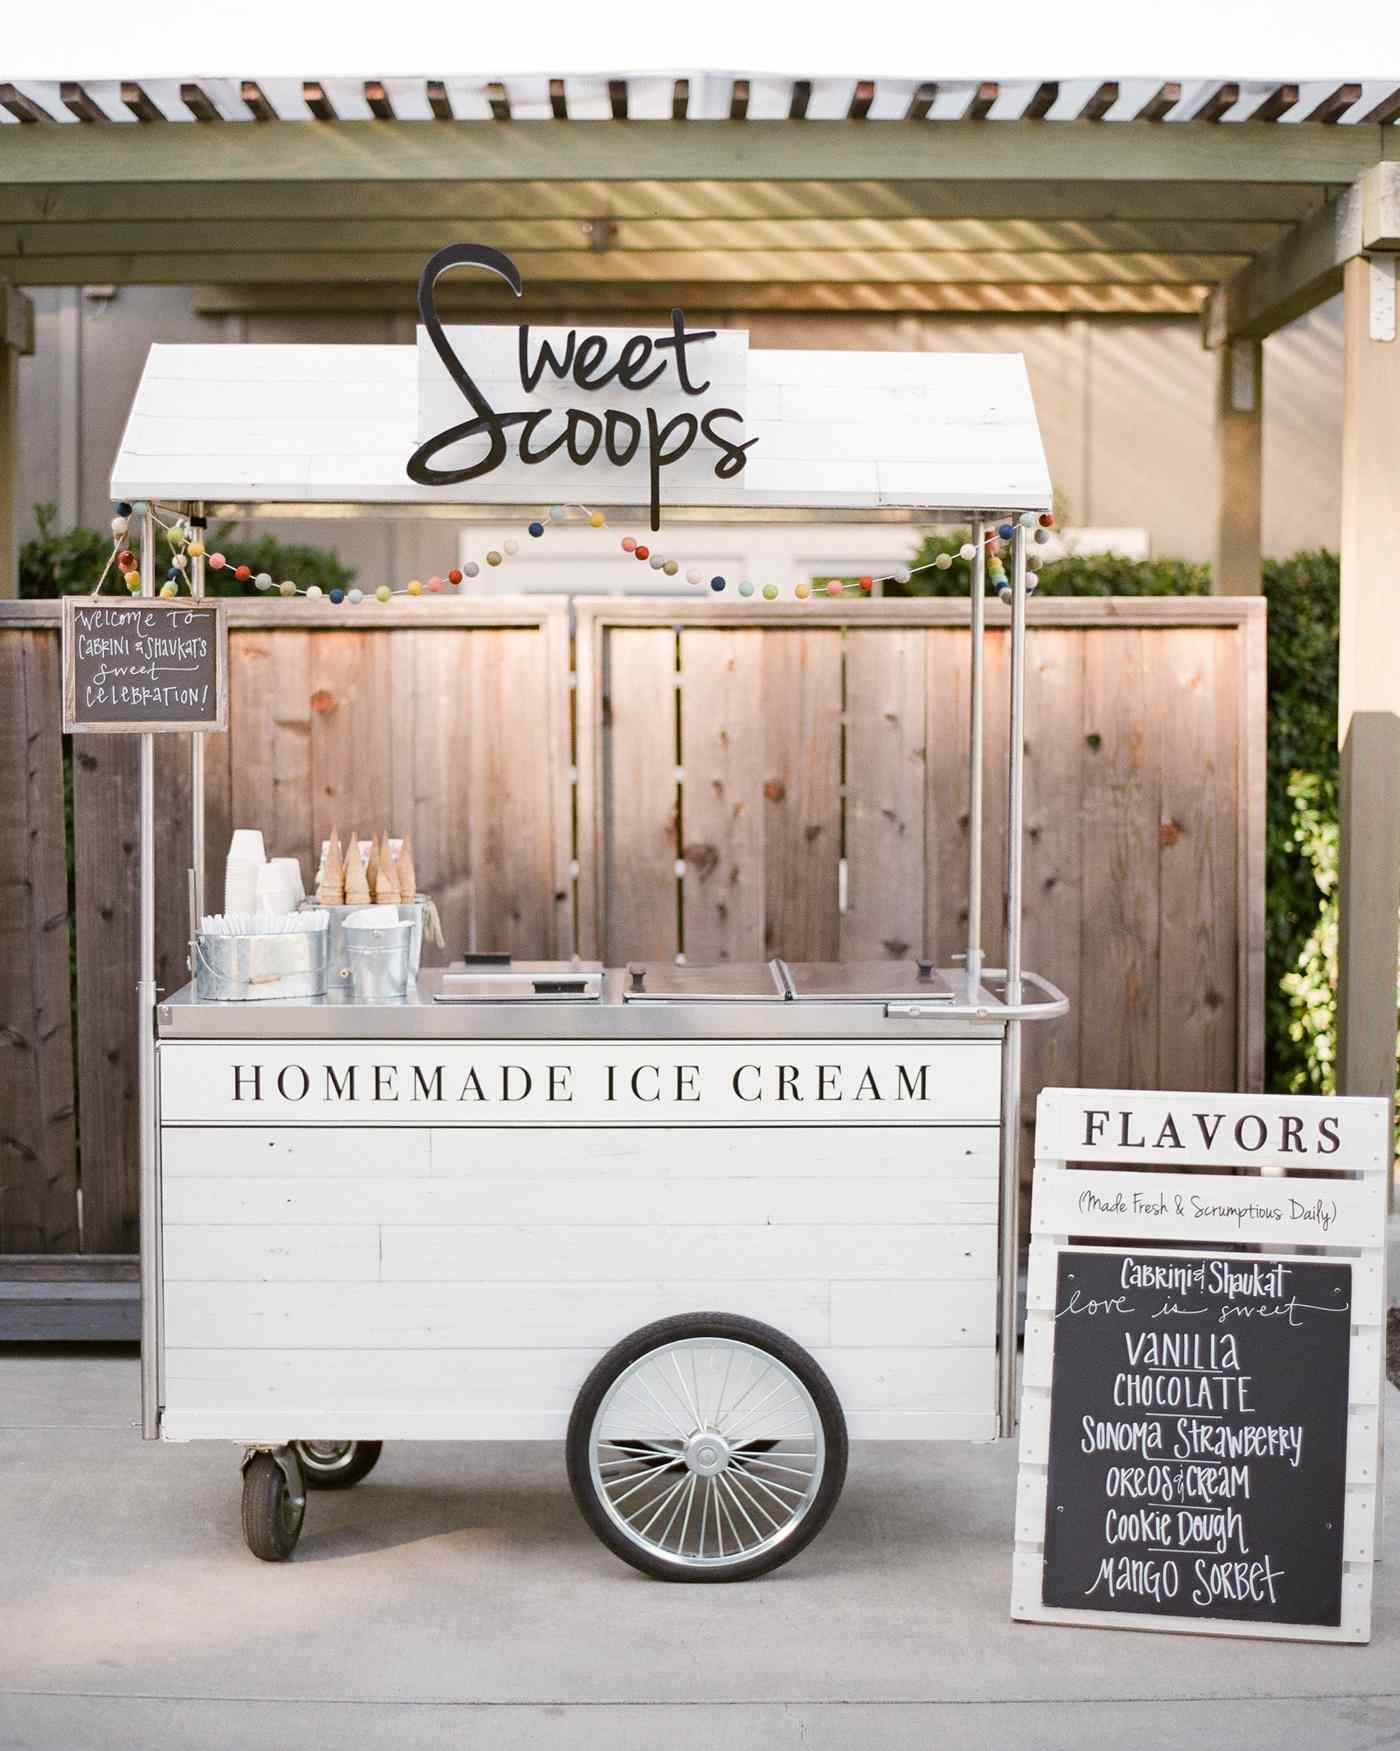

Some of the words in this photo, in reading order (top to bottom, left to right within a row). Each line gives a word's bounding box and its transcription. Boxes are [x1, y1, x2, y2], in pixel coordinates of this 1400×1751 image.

[231, 1064, 574, 1102] HOMEMADE
[604, 1064, 702, 1102] ICE
[733, 1064, 933, 1102] CREAM
[1081, 1109, 1342, 1155] FLAVORS
[1078, 1189, 1128, 1215] (Made
[1132, 1192, 1168, 1215] Fresh
[1174, 1194, 1184, 1216] &
[1190, 1195, 1282, 1228] Scrumptious
[1288, 1198, 1337, 1231] Daily)
[1055, 1290, 1136, 1320] love
[1152, 1295, 1208, 1320] is
[1113, 1374, 1255, 1413] CHOCOLATE
